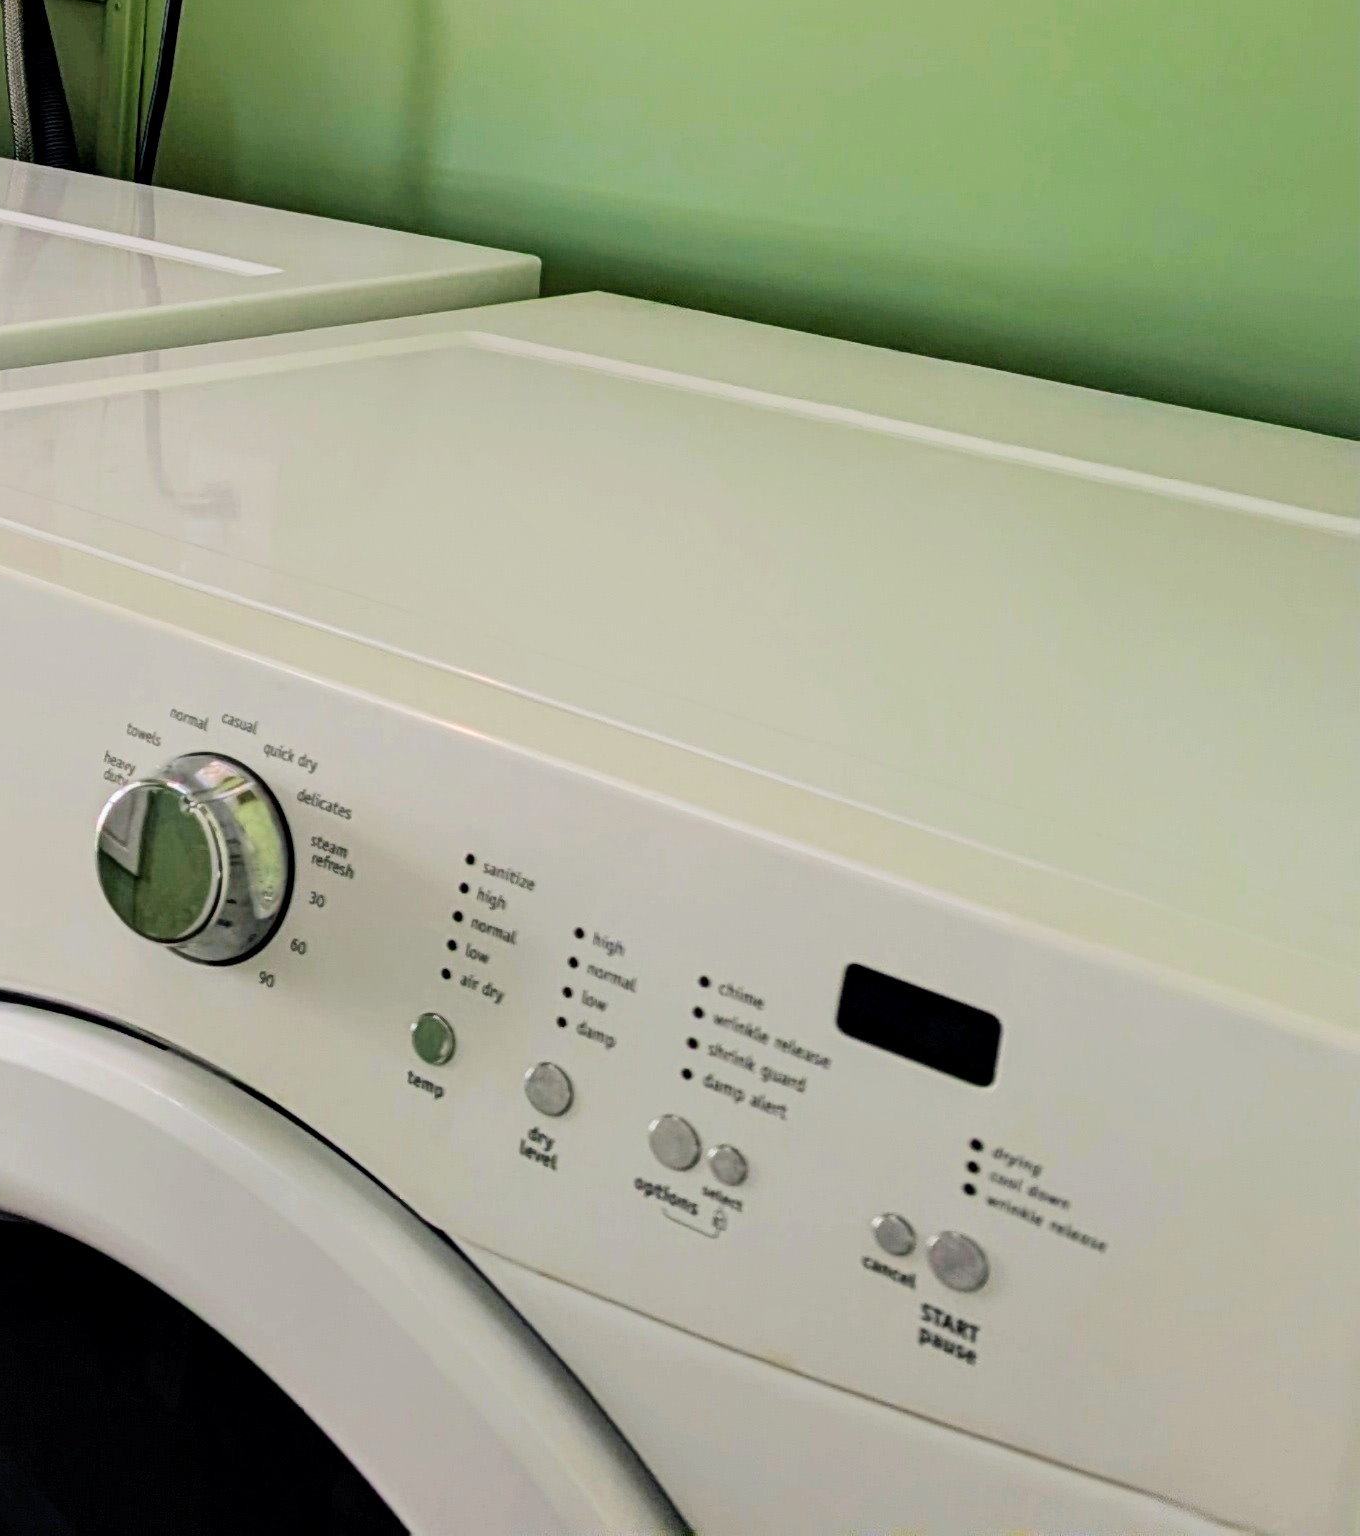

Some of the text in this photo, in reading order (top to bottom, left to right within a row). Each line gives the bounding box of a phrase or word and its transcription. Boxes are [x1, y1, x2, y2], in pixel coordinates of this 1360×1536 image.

[170, 707, 209, 732] normal
[221, 713, 258, 735] casual
[126, 723, 162, 747] towels
[103, 750, 136, 776] heavy
[263, 743, 318, 774] quick dry
[296, 789, 352, 821] delicates
[310, 835, 348, 859] steam
[311, 853, 354, 879] refresh
[483, 862, 536, 891] sanitize
[309, 891, 325, 908] 30
[476, 887, 507, 911] high
[471, 917, 517, 945] normal
[592, 932, 625, 956] high
[290, 938, 307, 955] 60
[465, 943, 490, 964] low
[259, 971, 274, 988] 90
[460, 972, 505, 1005] air dry
[586, 963, 637, 993] normal
[581, 989, 608, 1012] low
[718, 982, 765, 1010] chime
[576, 1022, 616, 1050] damp
[713, 1014, 831, 1069] wrinkle release
[708, 1043, 806, 1093] shrink guard
[407, 1069, 444, 1100] temp
[703, 1073, 787, 1120] damp alert
[528, 1127, 555, 1152] dry
[519, 1139, 557, 1171] level
[992, 1148, 1042, 1178] drying
[634, 1177, 698, 1216] options
[702, 1186, 743, 1212] select
[989, 1171, 1071, 1210] cool down
[986, 1196, 1108, 1254] wrinkle release
[861, 1256, 917, 1290] cancel
[920, 1303, 981, 1343] START
[917, 1328, 977, 1365] pause
